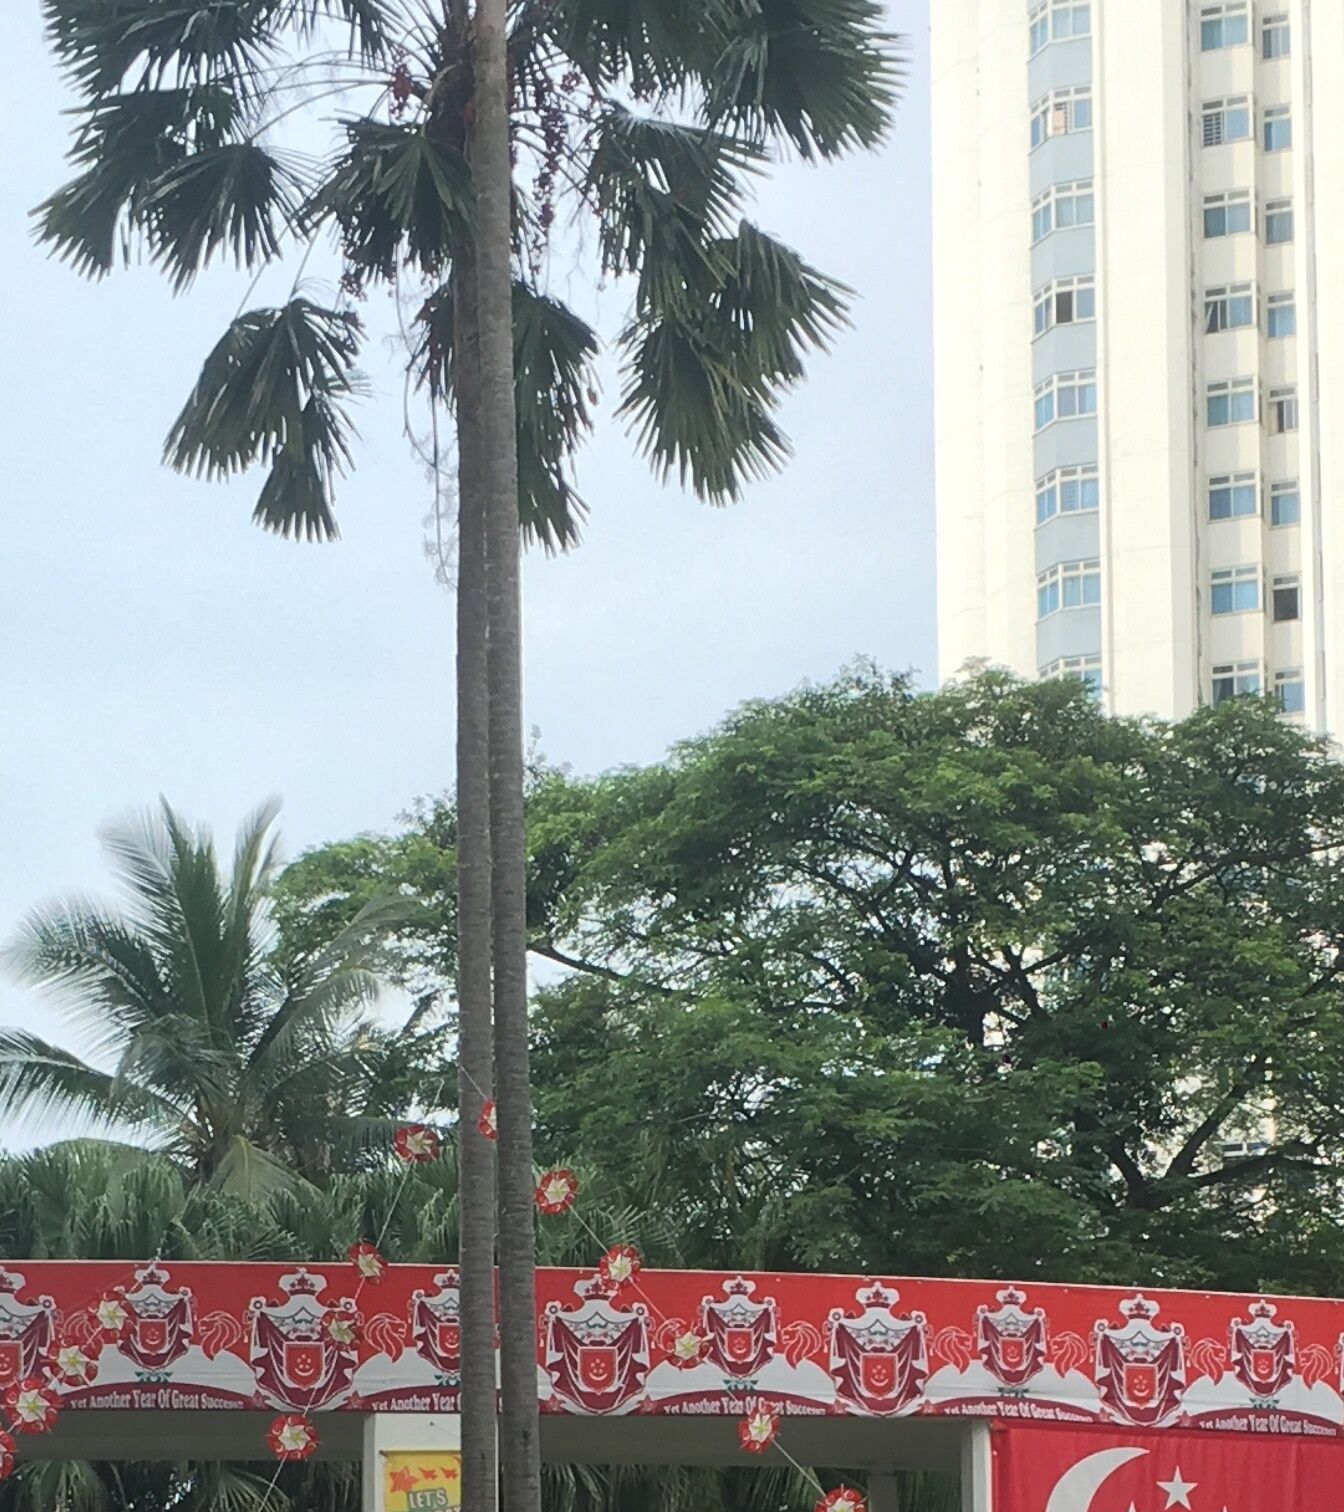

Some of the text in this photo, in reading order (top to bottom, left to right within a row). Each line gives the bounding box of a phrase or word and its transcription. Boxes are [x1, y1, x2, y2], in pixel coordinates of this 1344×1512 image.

[89, 1391, 132, 1409] Another
[132, 1389, 156, 1408] Year
[159, 1388, 171, 1409] Of
[171, 1389, 199, 1409] Great
[390, 1393, 431, 1411] Another
[432, 1393, 455, 1411] Year
